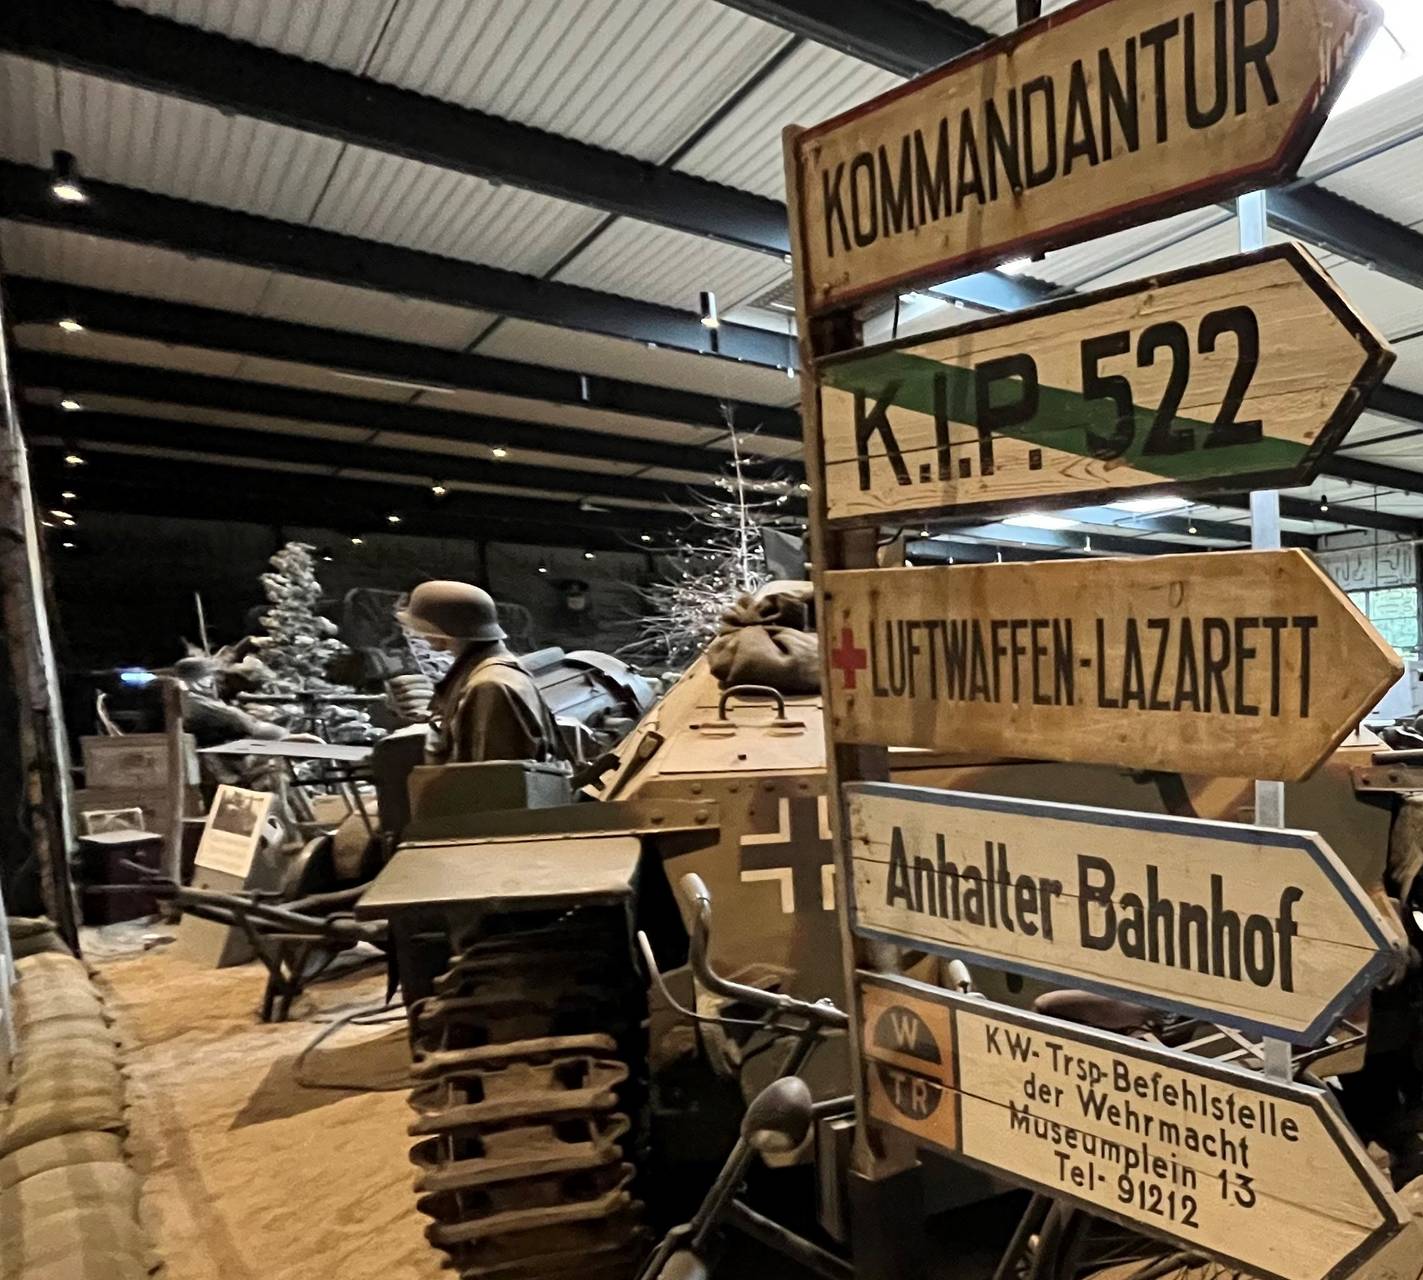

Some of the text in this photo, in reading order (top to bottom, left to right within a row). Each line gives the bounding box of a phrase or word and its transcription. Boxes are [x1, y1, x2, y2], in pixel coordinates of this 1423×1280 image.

[821, 0, 1281, 258] KOMMANDANTUR
[855, 305, 1263, 491] K.I.P. 522
[870, 614, 1318, 718] LUFTWAFFEN-LAZARETT
[886, 826, 1304, 993] Anhalter Bahnhof
[891, 1013, 919, 1049] W
[889, 1070, 927, 1114] TR
[1023, 1072, 1249, 1168] der Wehrmacht
[1009, 1100, 1256, 1208] Museumplein 13
[1054, 1150, 1199, 1228] Tel- 91212
